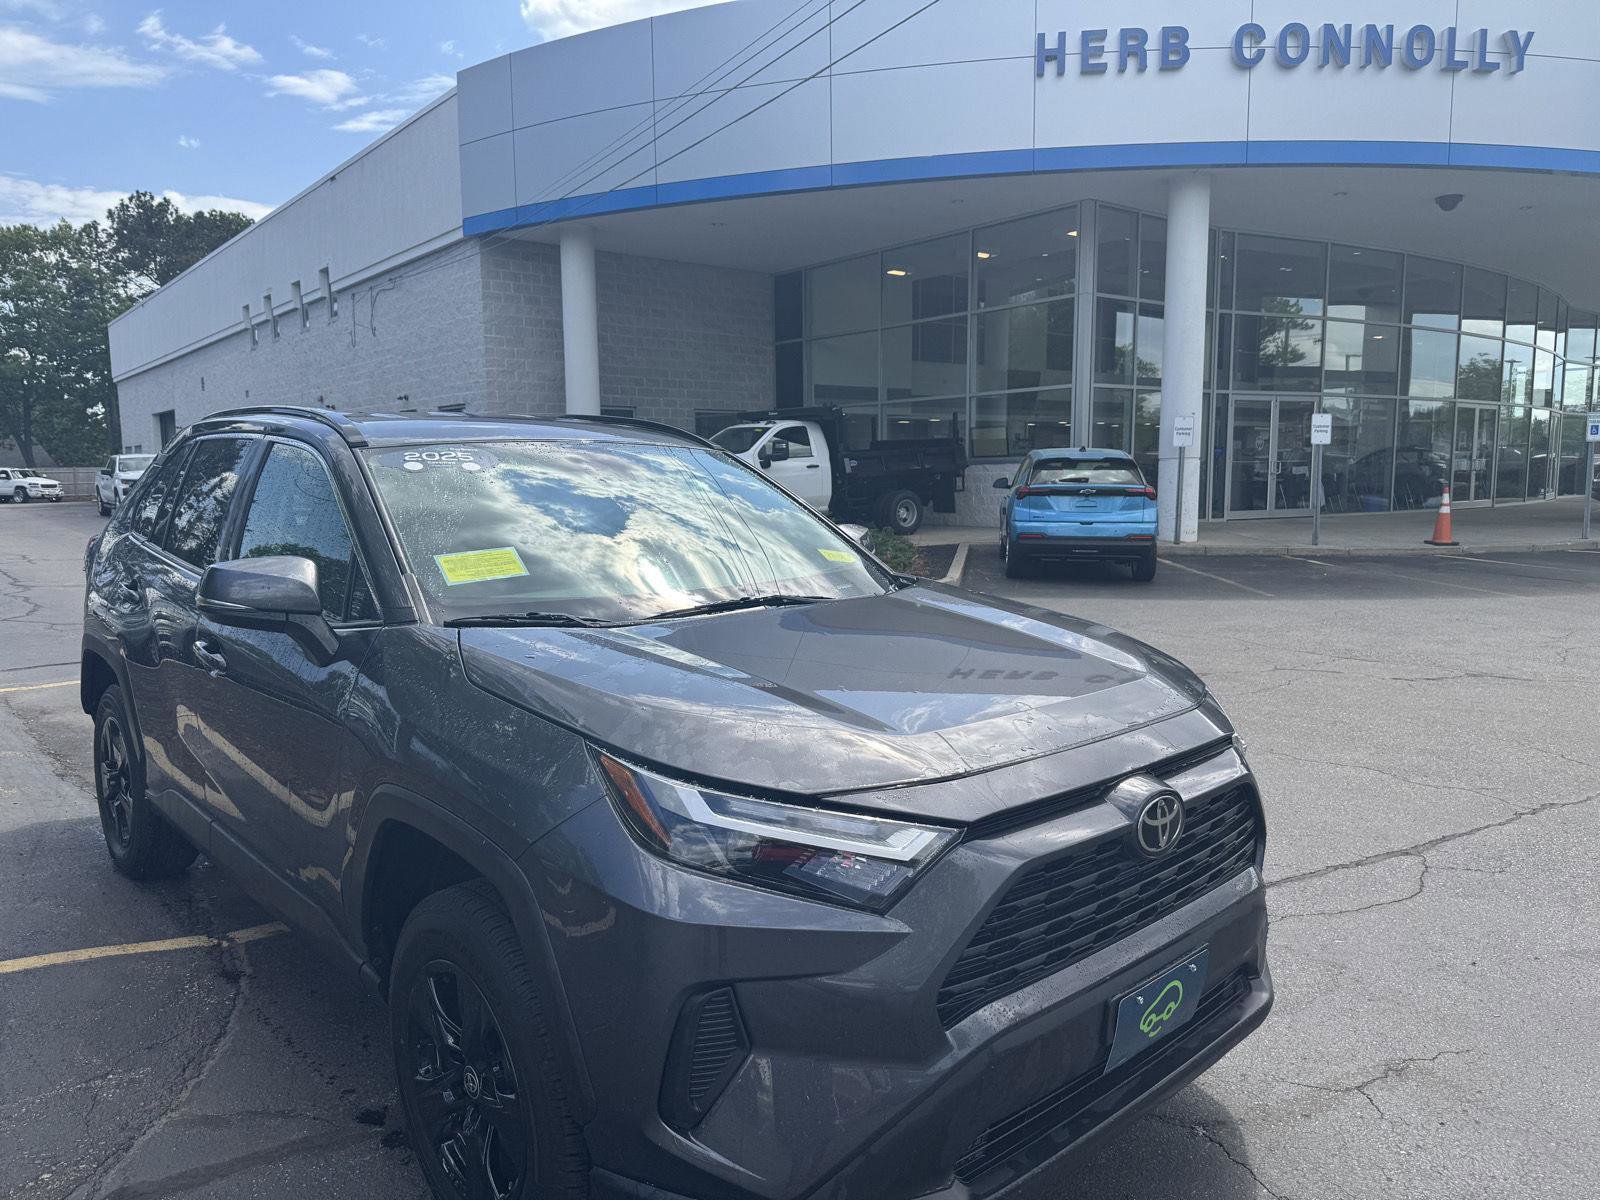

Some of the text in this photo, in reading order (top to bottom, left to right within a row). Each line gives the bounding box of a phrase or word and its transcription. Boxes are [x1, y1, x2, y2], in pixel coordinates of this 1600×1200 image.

[1036, 22, 1535, 77] HERB CONNOLLY
[403, 451, 474, 461] 2025
